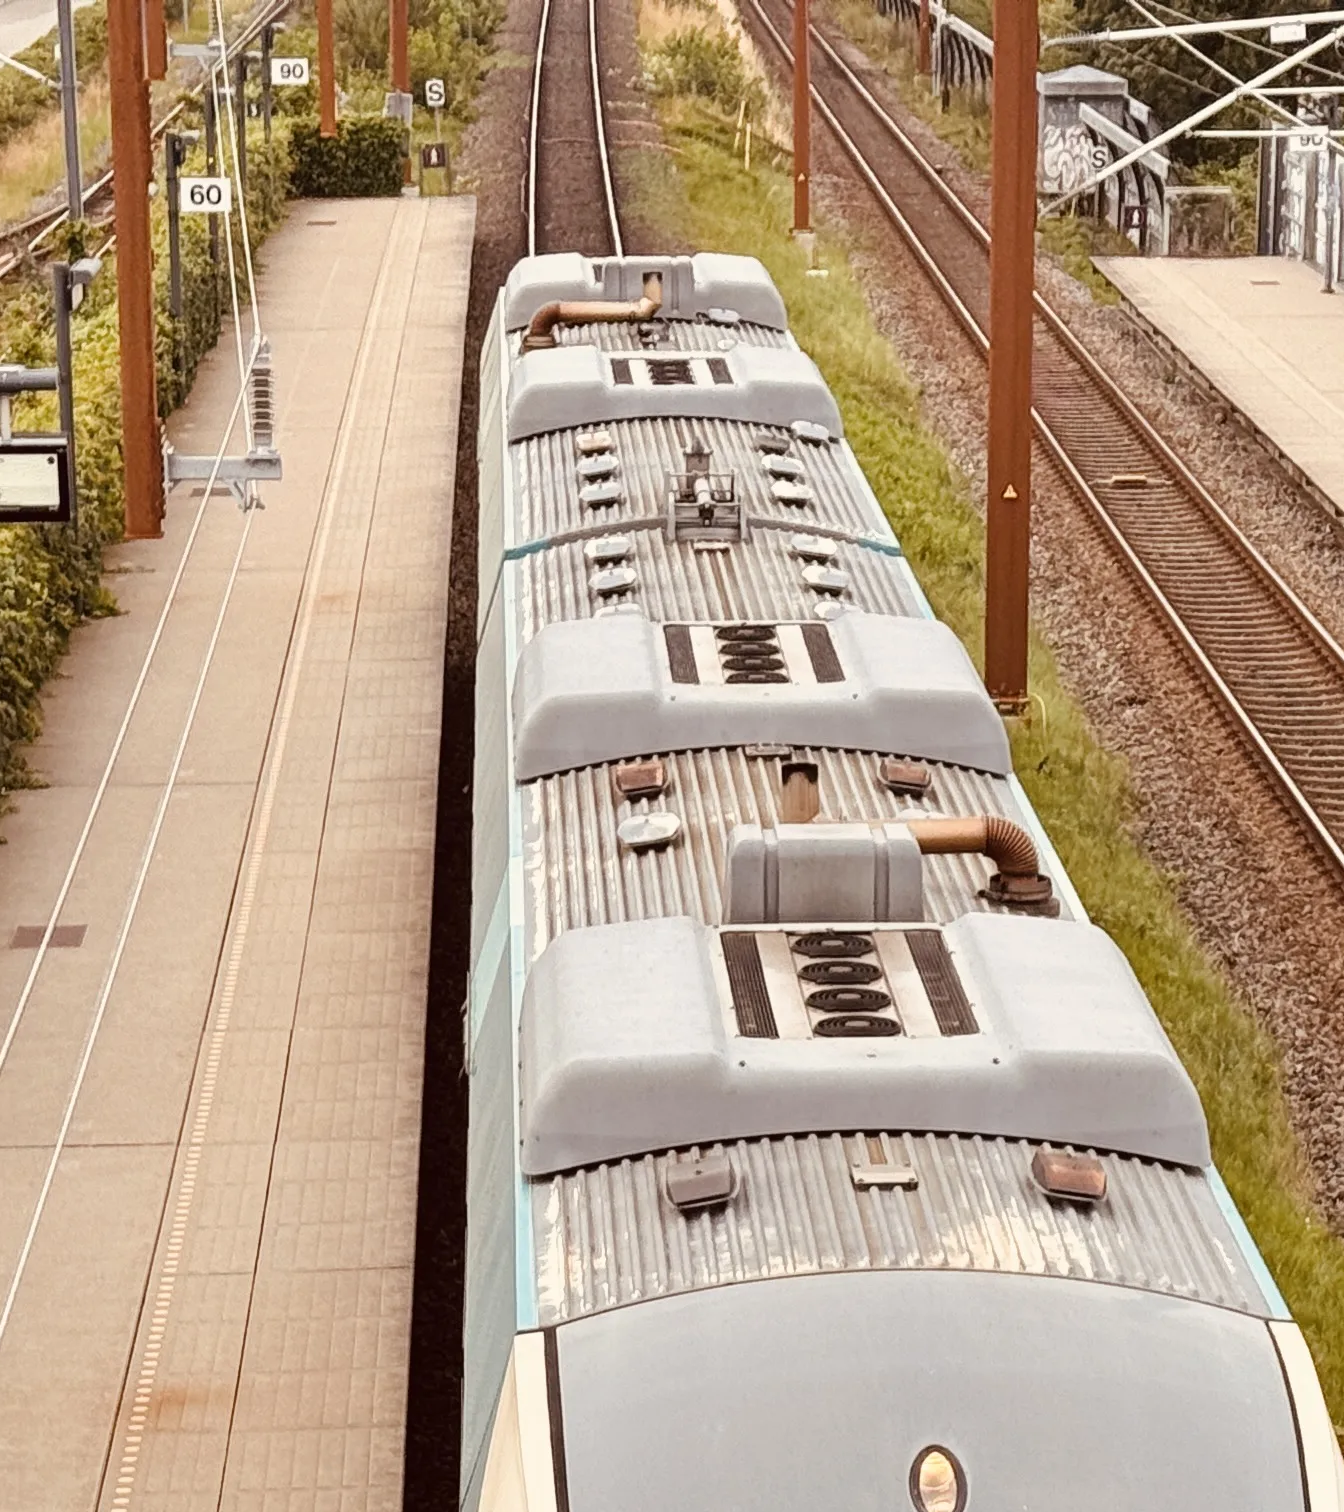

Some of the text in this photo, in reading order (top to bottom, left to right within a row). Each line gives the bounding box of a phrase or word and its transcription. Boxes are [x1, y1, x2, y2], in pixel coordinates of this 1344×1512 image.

[280, 63, 304, 79] 90
[428, 82, 444, 102] S
[1091, 149, 1107, 169] S
[190, 184, 222, 205] 60
